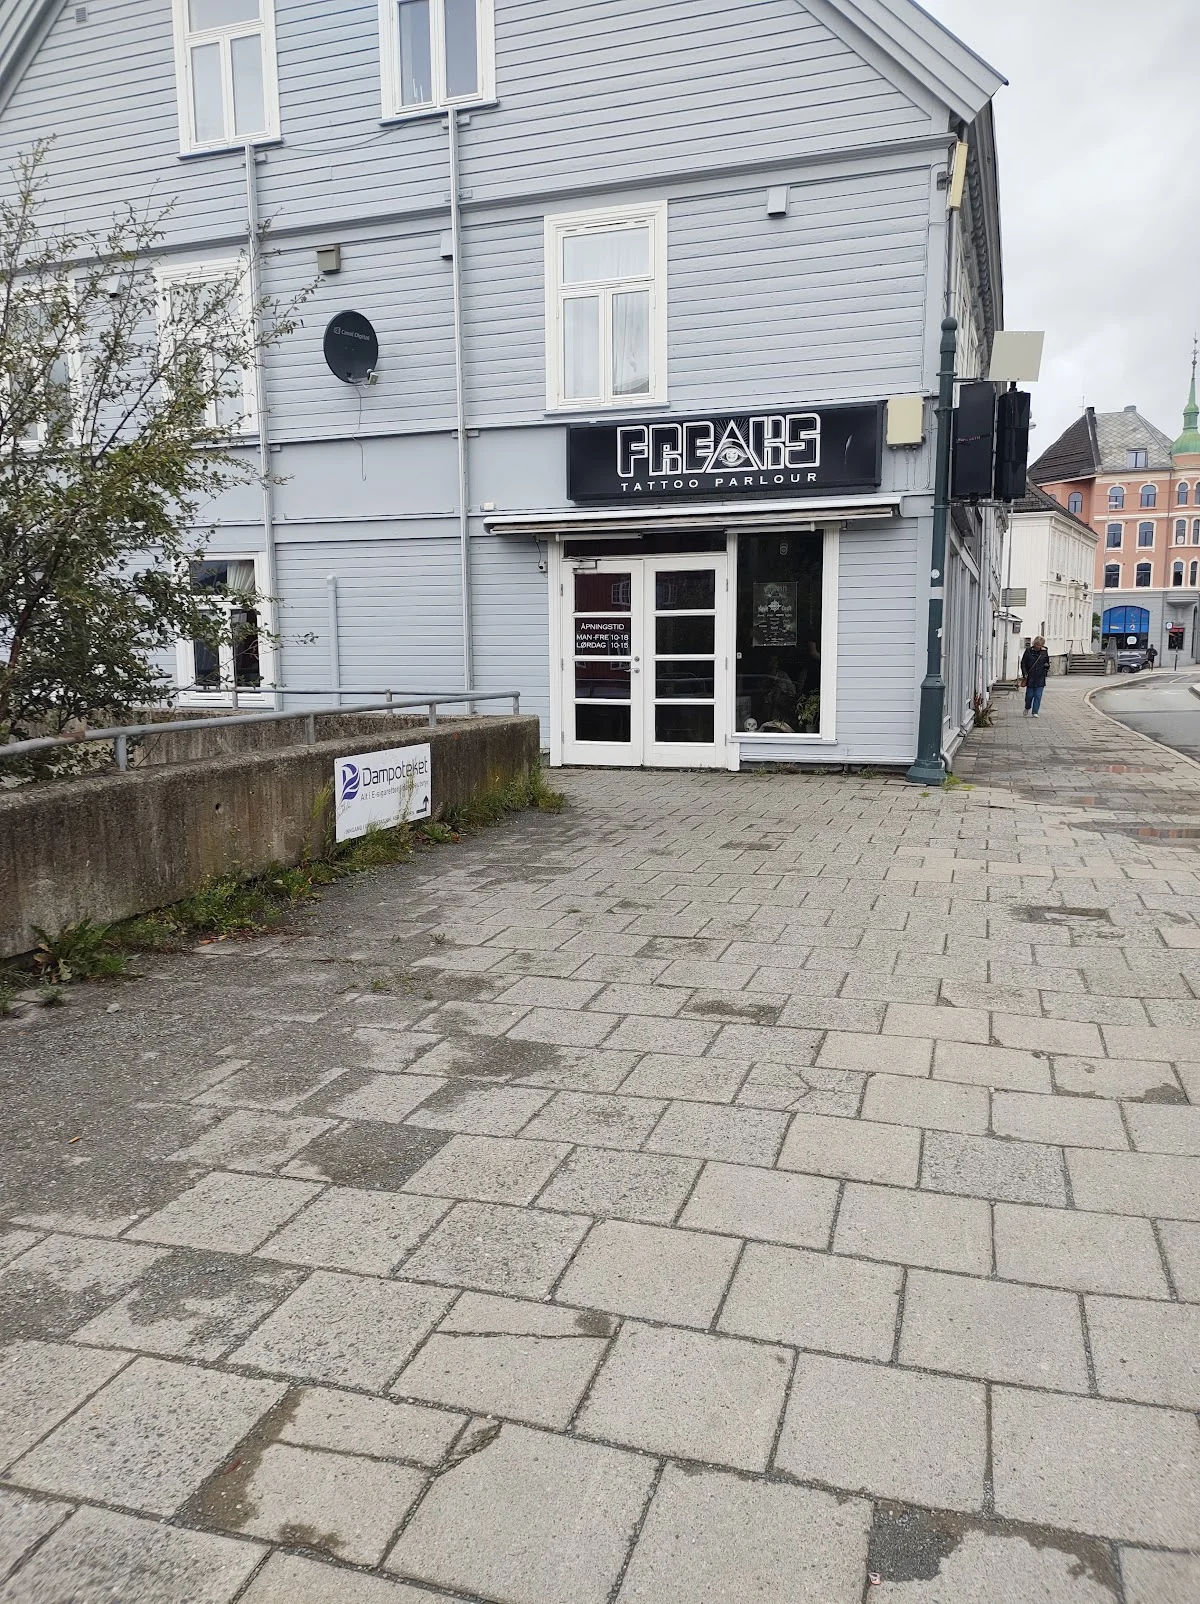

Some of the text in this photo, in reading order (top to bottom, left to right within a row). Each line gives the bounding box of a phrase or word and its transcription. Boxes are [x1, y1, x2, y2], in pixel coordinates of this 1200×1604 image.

[616, 412, 821, 478] FREAKS
[621, 472, 817, 492] TATTOO PARLOUR
[580, 622, 625, 630] ÅPNINGSTID
[362, 757, 428, 787] Dampoteket
